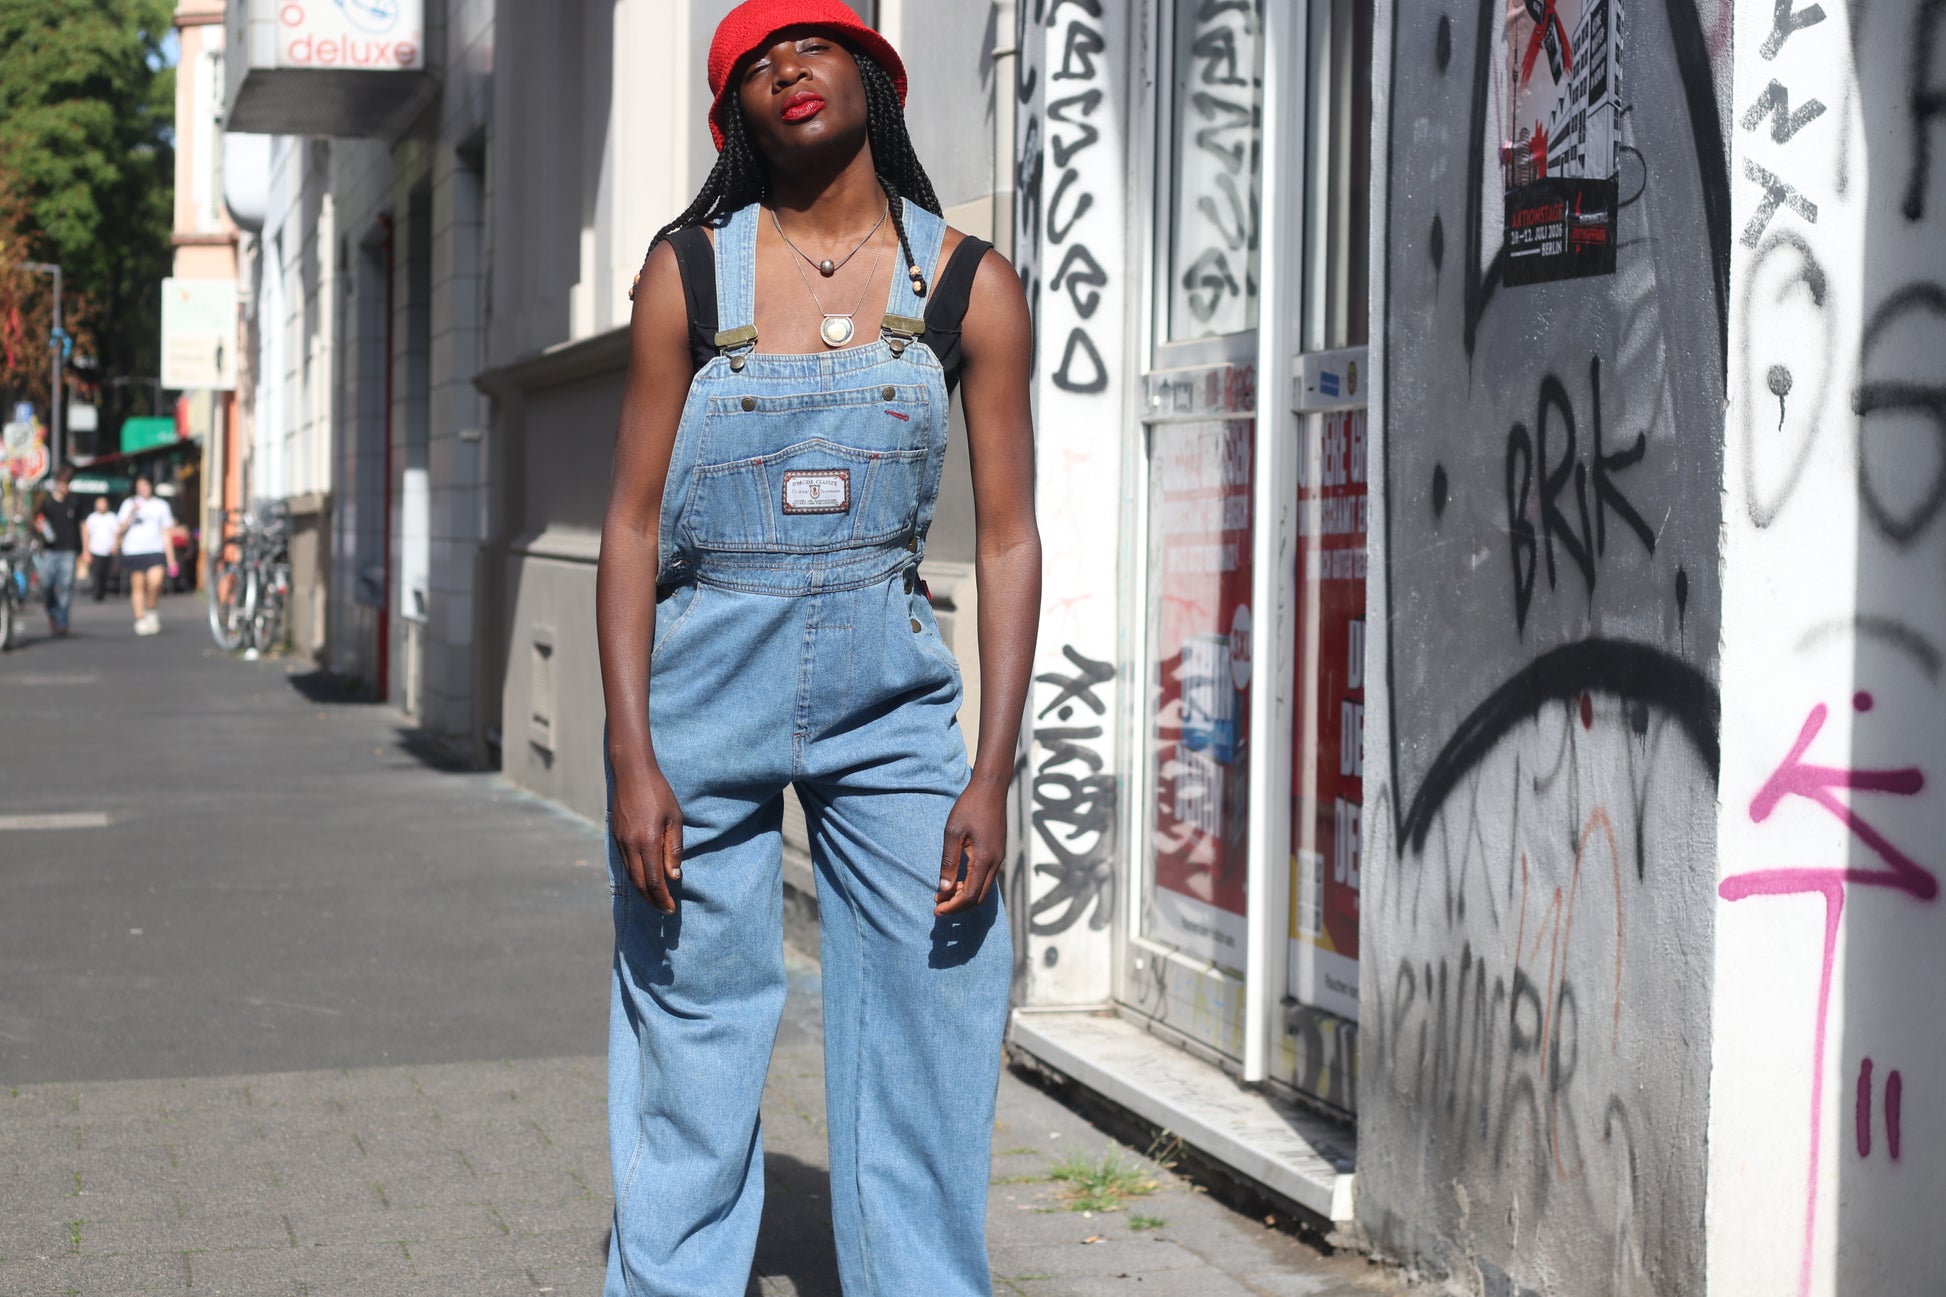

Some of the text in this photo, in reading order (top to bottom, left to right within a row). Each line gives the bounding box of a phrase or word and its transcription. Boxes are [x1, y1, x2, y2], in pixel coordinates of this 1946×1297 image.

[288, 33, 417, 66] deluxe
[1535, 225, 1548, 240] JULI
[1541, 240, 1563, 256] BERLIN
